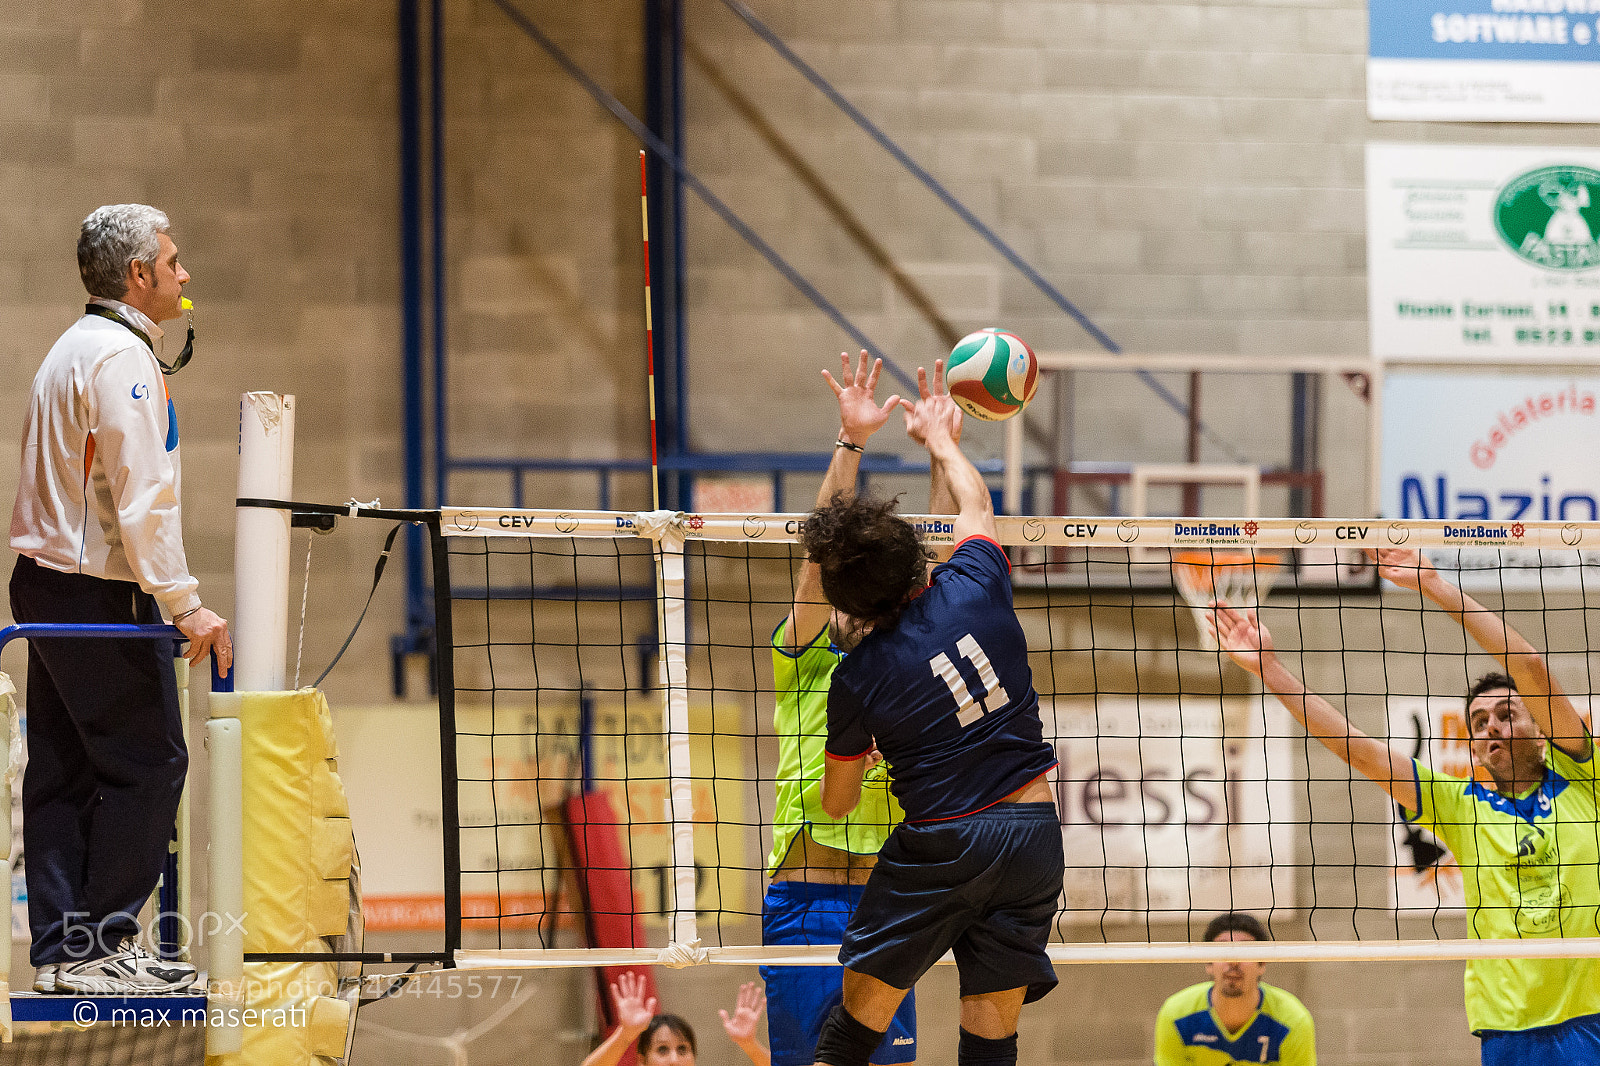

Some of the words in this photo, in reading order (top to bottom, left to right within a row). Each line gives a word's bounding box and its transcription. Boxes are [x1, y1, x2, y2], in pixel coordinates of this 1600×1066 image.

[1431, 13, 1568, 44] SOFTWARE
[1470, 384, 1597, 470] Gelateria
[498, 515, 535, 529] CEV
[785, 520, 805, 535] CE
[1063, 524, 1098, 538] CEV
[1174, 523, 1240, 536] DenizBank
[1335, 526, 1369, 540] CEV
[1443, 525, 1508, 538] DenizBank
[929, 633, 990, 728] 11
